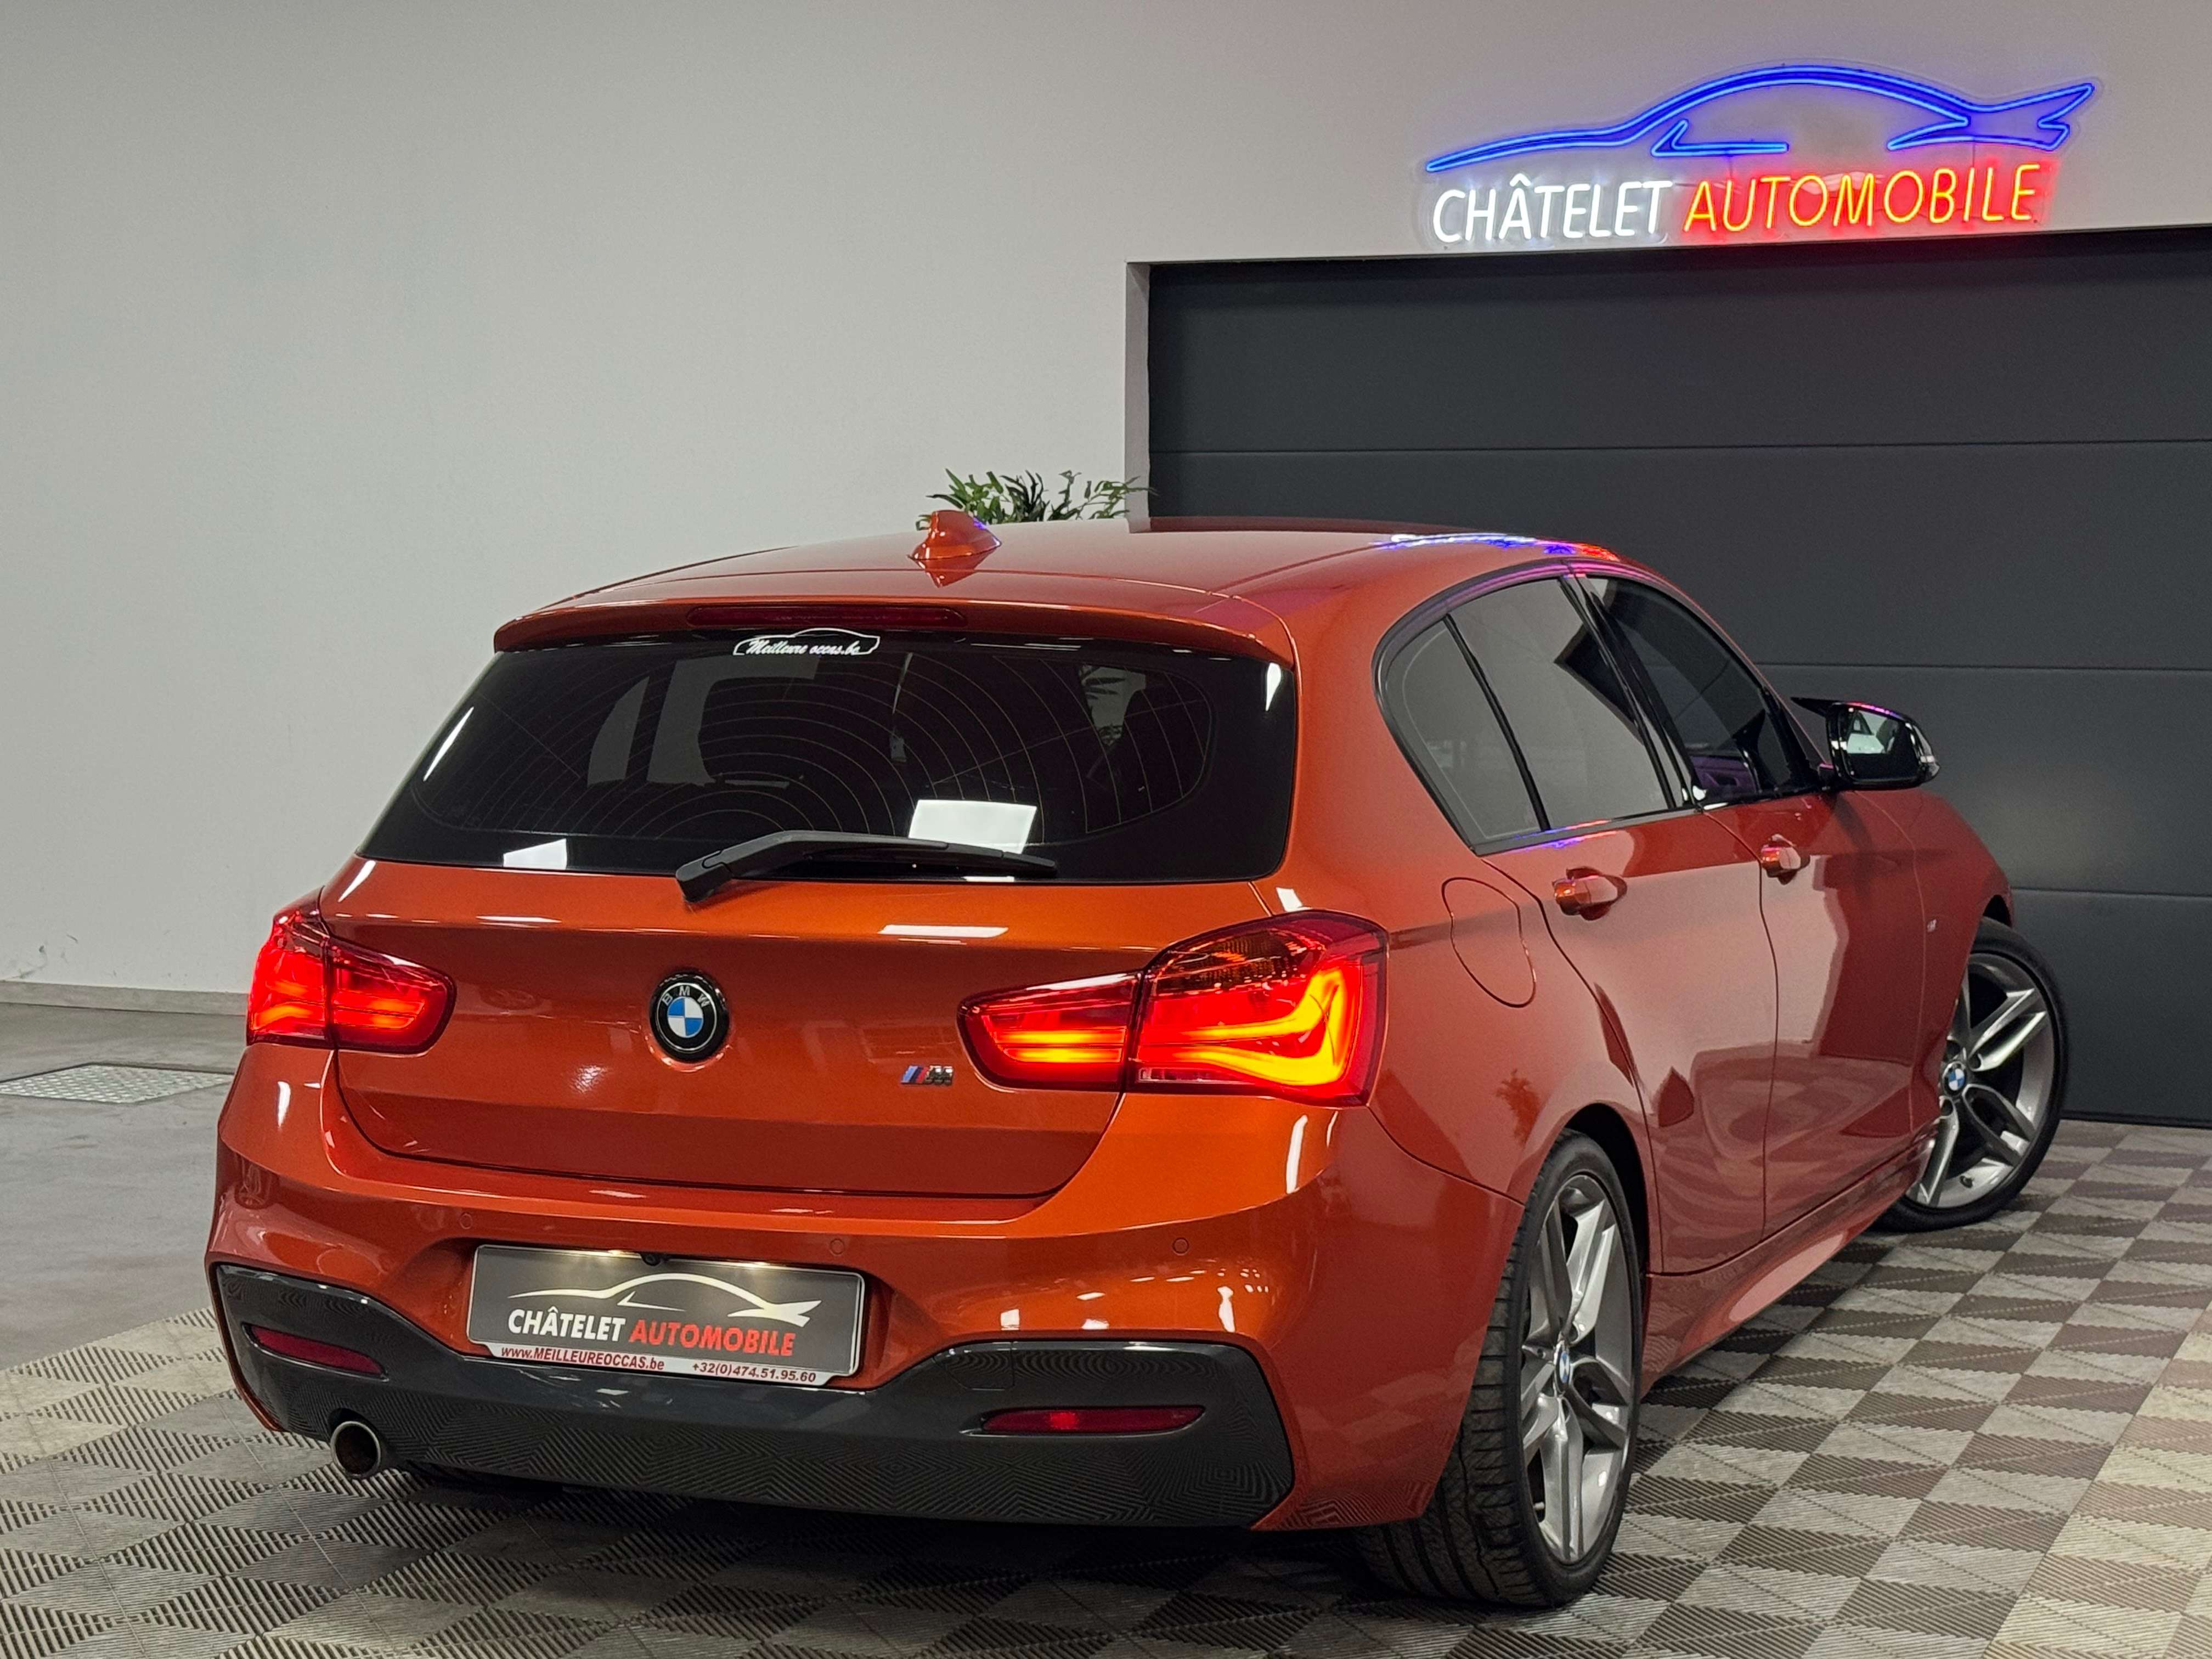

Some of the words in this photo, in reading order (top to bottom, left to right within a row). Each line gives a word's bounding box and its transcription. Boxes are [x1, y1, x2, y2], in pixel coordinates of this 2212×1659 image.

[1431, 174, 1673, 244] CHÂTELET
[1683, 162, 2040, 233] AUTOMOBILE
[662, 985, 710, 1008] BMW
[508, 1306, 626, 1342] CHÂTELET
[628, 1319, 796, 1357] AUTOMOBILE
[501, 1347, 665, 1370] www.MEILLEUREOCCAS.be
[692, 1362, 816, 1383] +32(0)474.51.95.60
